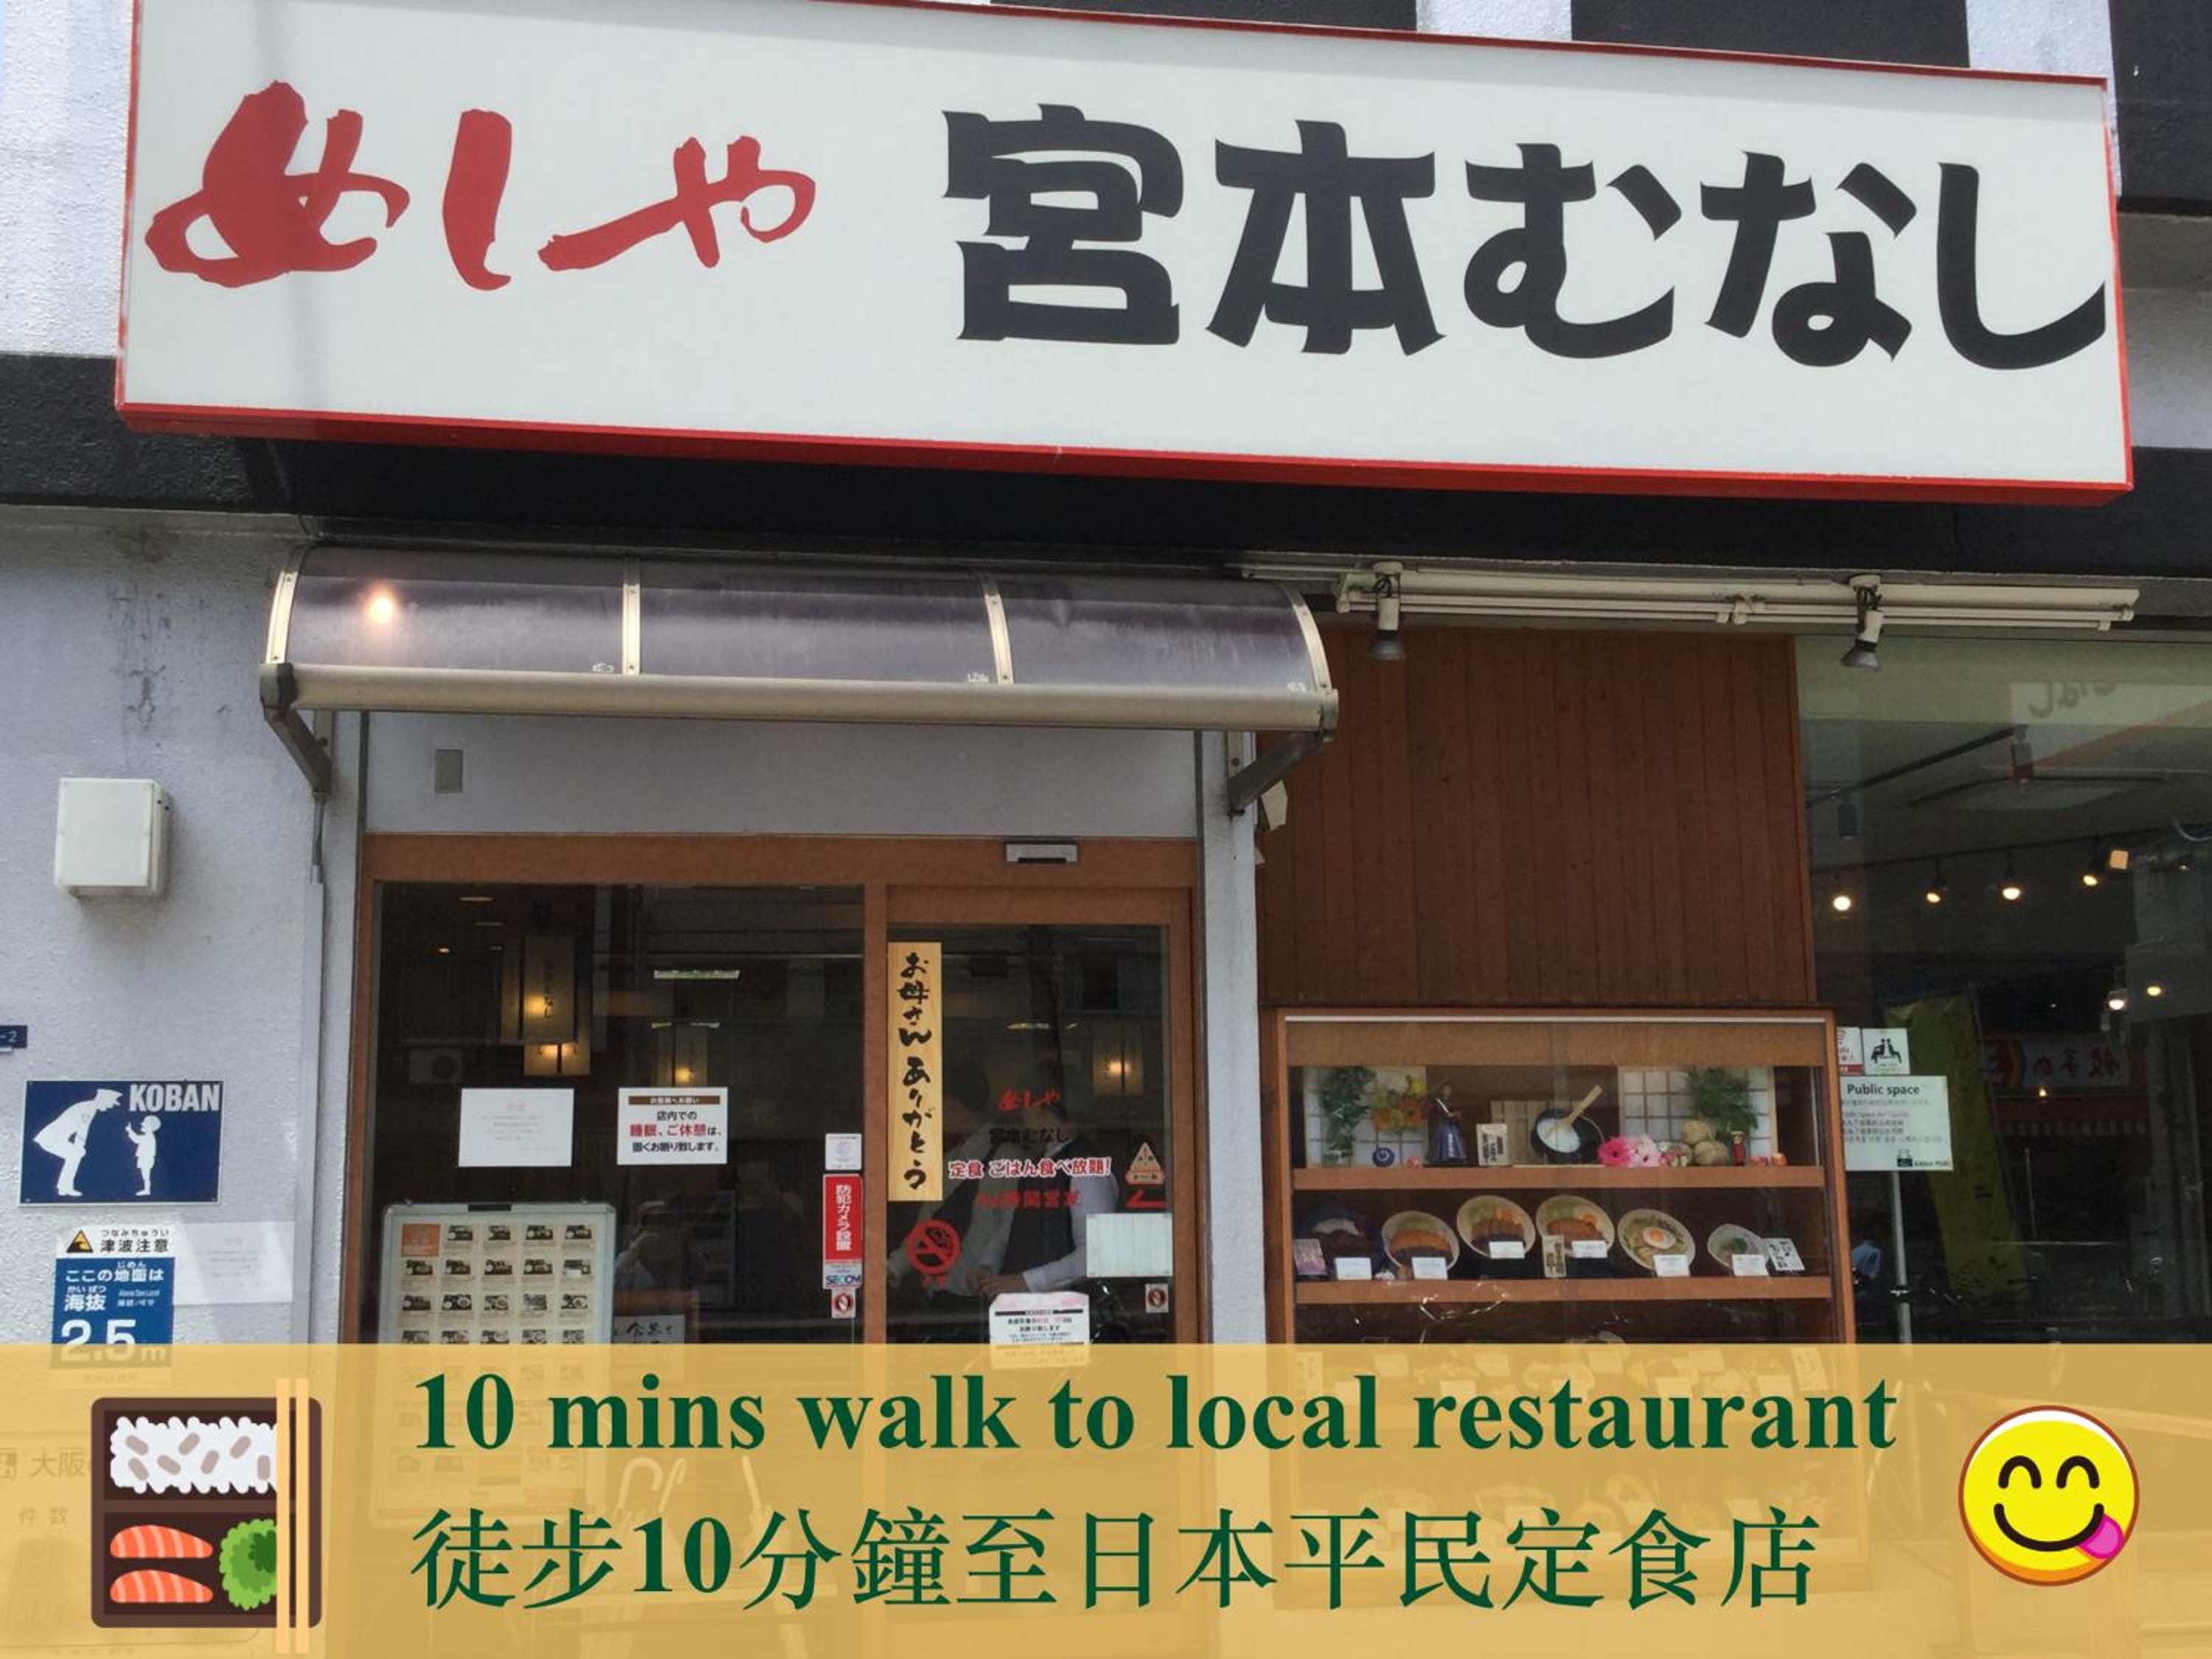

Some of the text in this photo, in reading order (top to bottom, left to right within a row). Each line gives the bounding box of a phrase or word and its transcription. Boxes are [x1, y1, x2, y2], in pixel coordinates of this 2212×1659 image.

[145, 80, 2107, 371] めしや 宮本むなし
[128, 1083, 220, 1112] KOBAN
[1847, 1084, 1920, 1097] Public space
[656, 1110, 698, 1121] 店内での
[949, 1160, 984, 1178] 定食
[835, 1184, 852, 1251] 防犯カメラ設置
[100, 1239, 169, 1253] 津波注意
[66, 1267, 164, 1282] ここの地面は
[64, 1294, 106, 1312] 海抜
